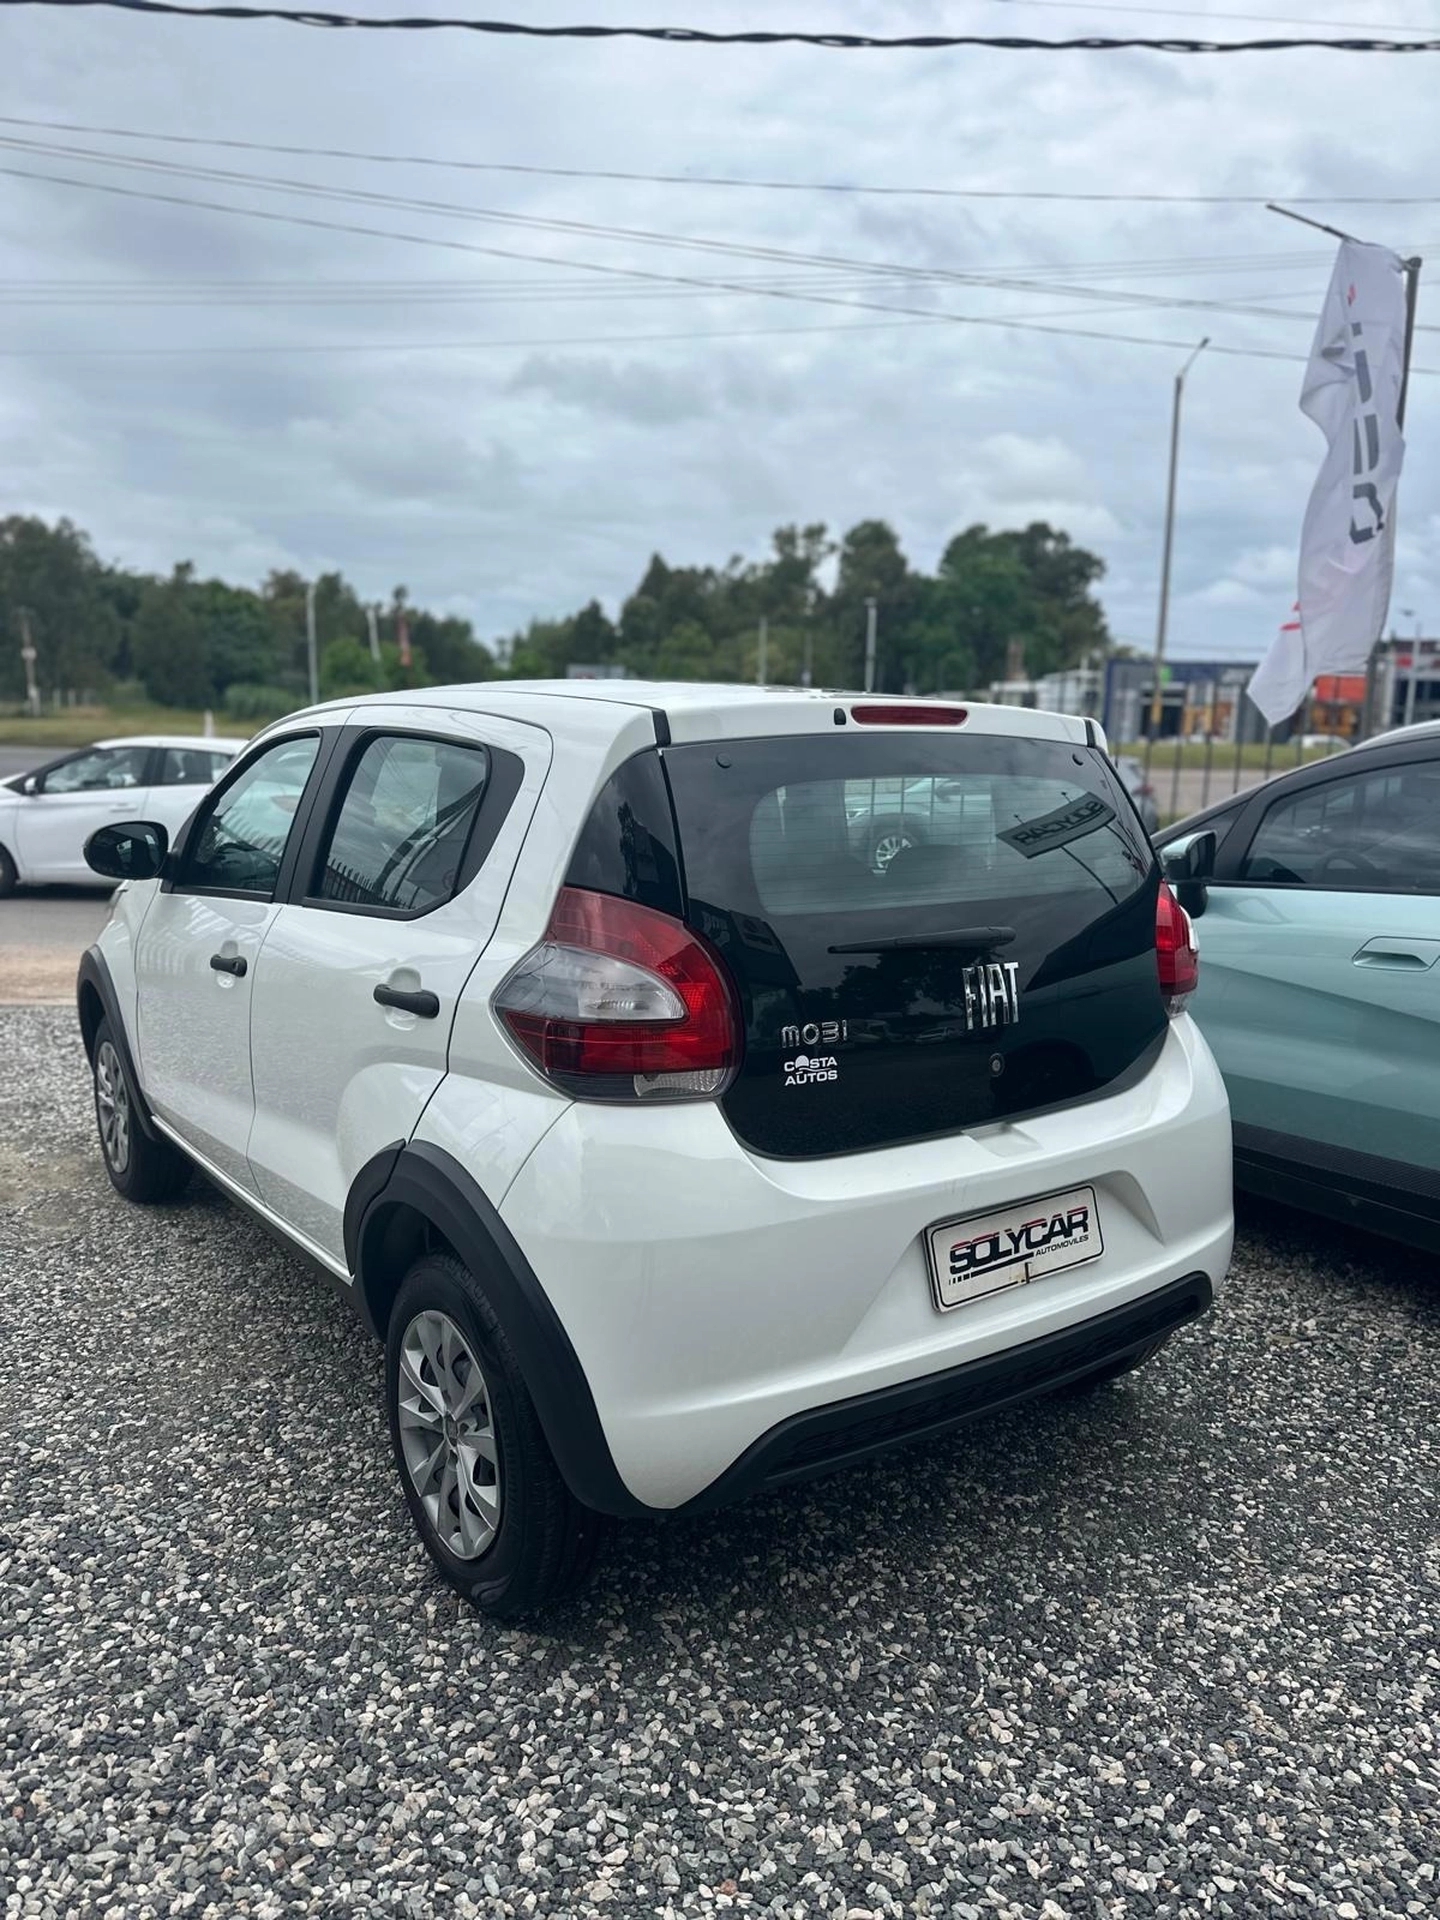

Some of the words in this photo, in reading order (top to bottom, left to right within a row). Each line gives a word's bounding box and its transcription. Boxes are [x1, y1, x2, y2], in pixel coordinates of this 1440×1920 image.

[962, 962, 1019, 1030] FIAT
[781, 1019, 848, 1048] MOBI
[784, 1055, 838, 1072] COSTA
[785, 1070, 838, 1086] AUTOS
[949, 1206, 1089, 1275] SOLYCAR
[1035, 1234, 1089, 1257] AUTOMOVILES
